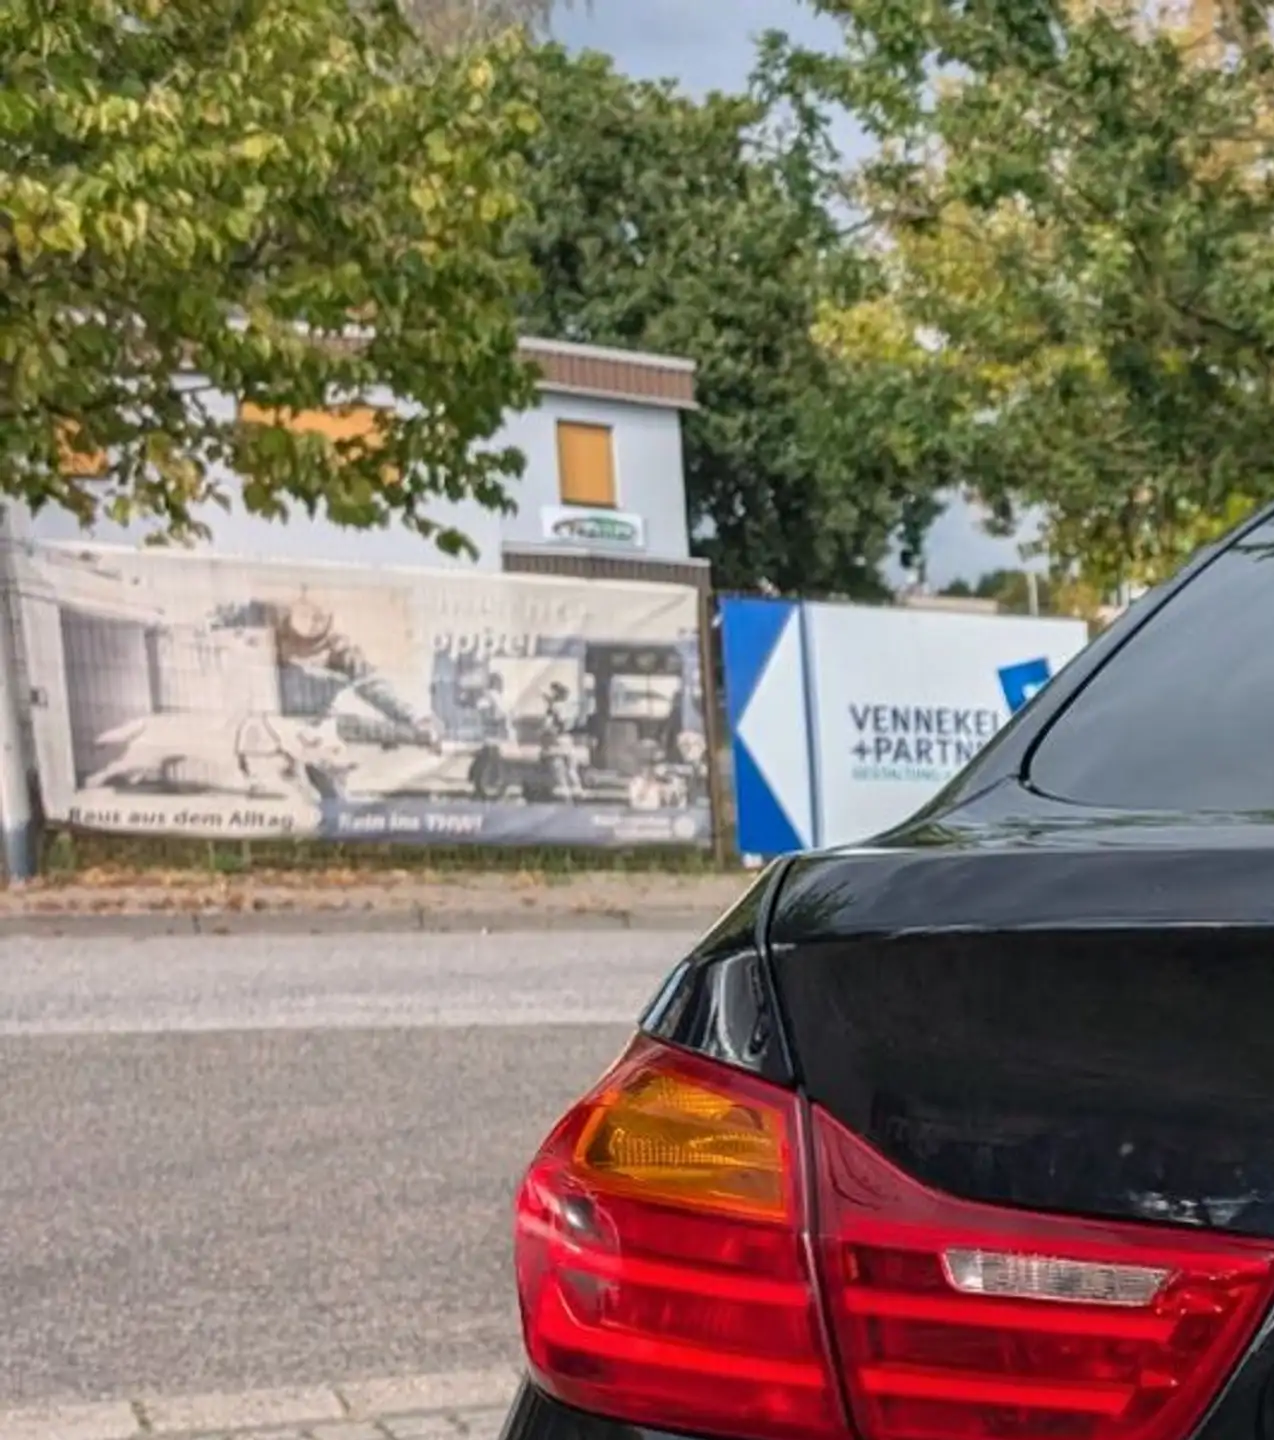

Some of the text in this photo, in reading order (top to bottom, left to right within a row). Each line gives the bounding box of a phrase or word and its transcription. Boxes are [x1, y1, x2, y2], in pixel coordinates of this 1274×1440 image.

[851, 737, 986, 765] +PARTN
[68, 807, 295, 830] Raus aus dem Alltag
